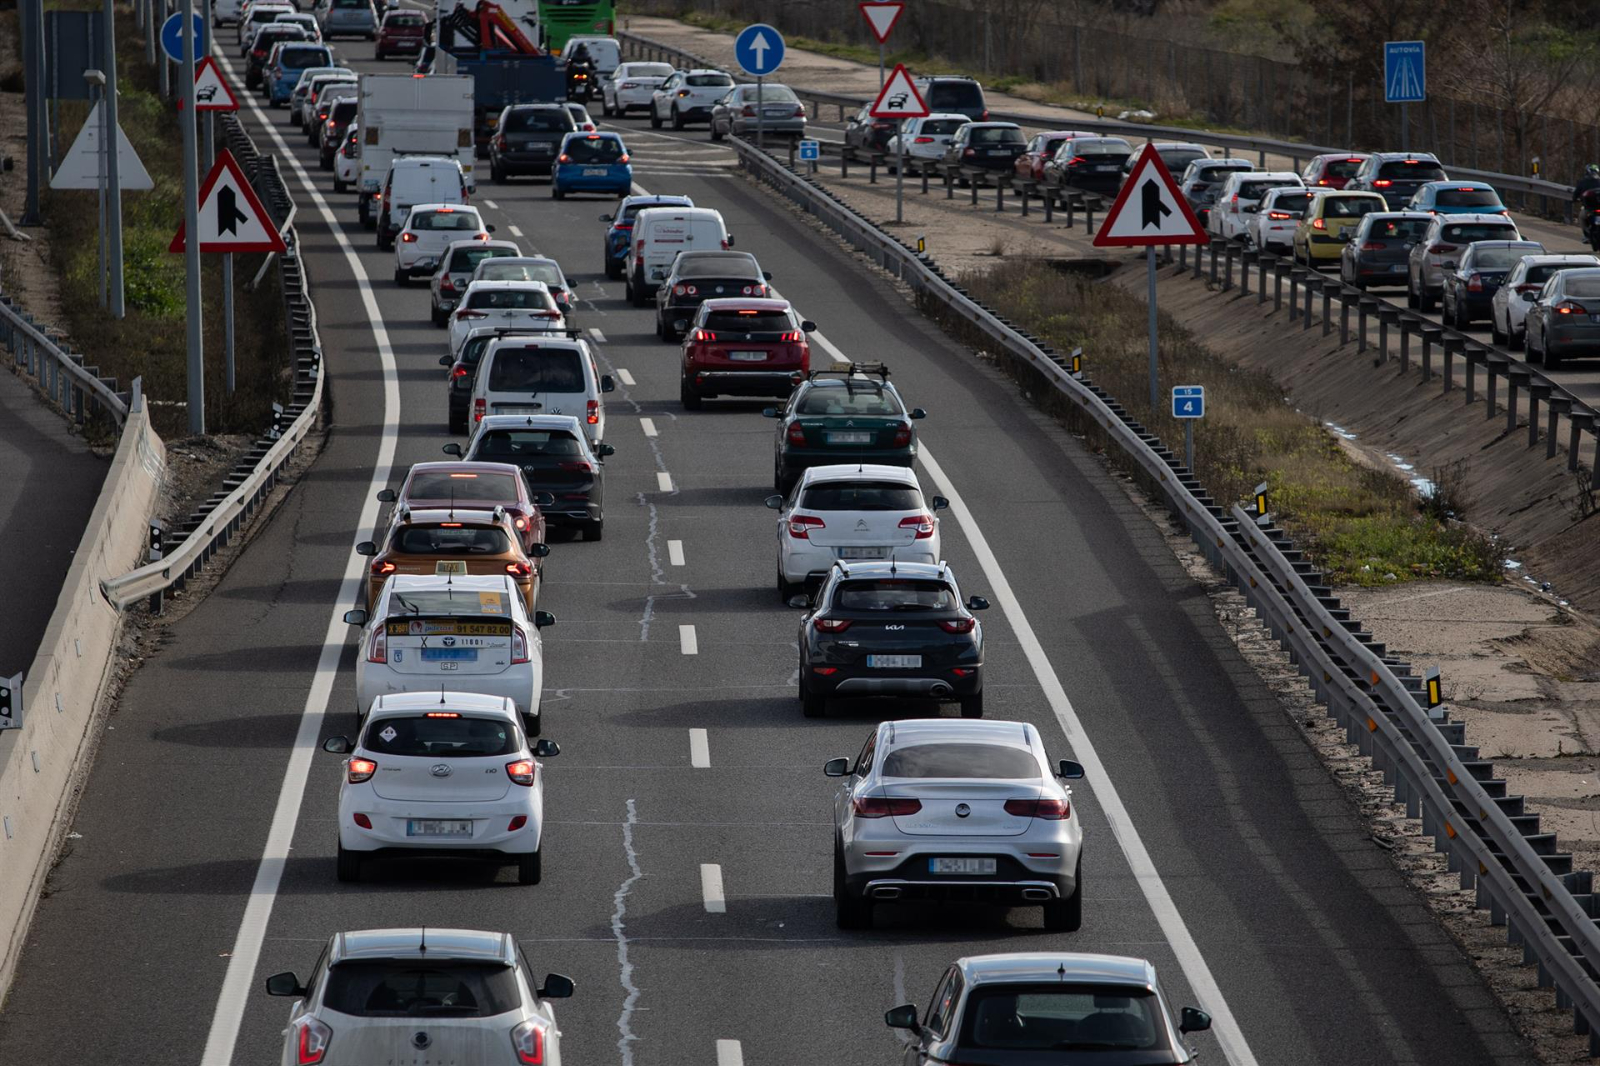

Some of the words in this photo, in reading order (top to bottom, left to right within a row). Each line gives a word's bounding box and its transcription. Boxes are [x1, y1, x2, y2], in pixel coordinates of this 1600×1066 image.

[1183, 401, 1193, 412] 4
[470, 625, 485, 634] 547
[499, 625, 510, 634] 00
